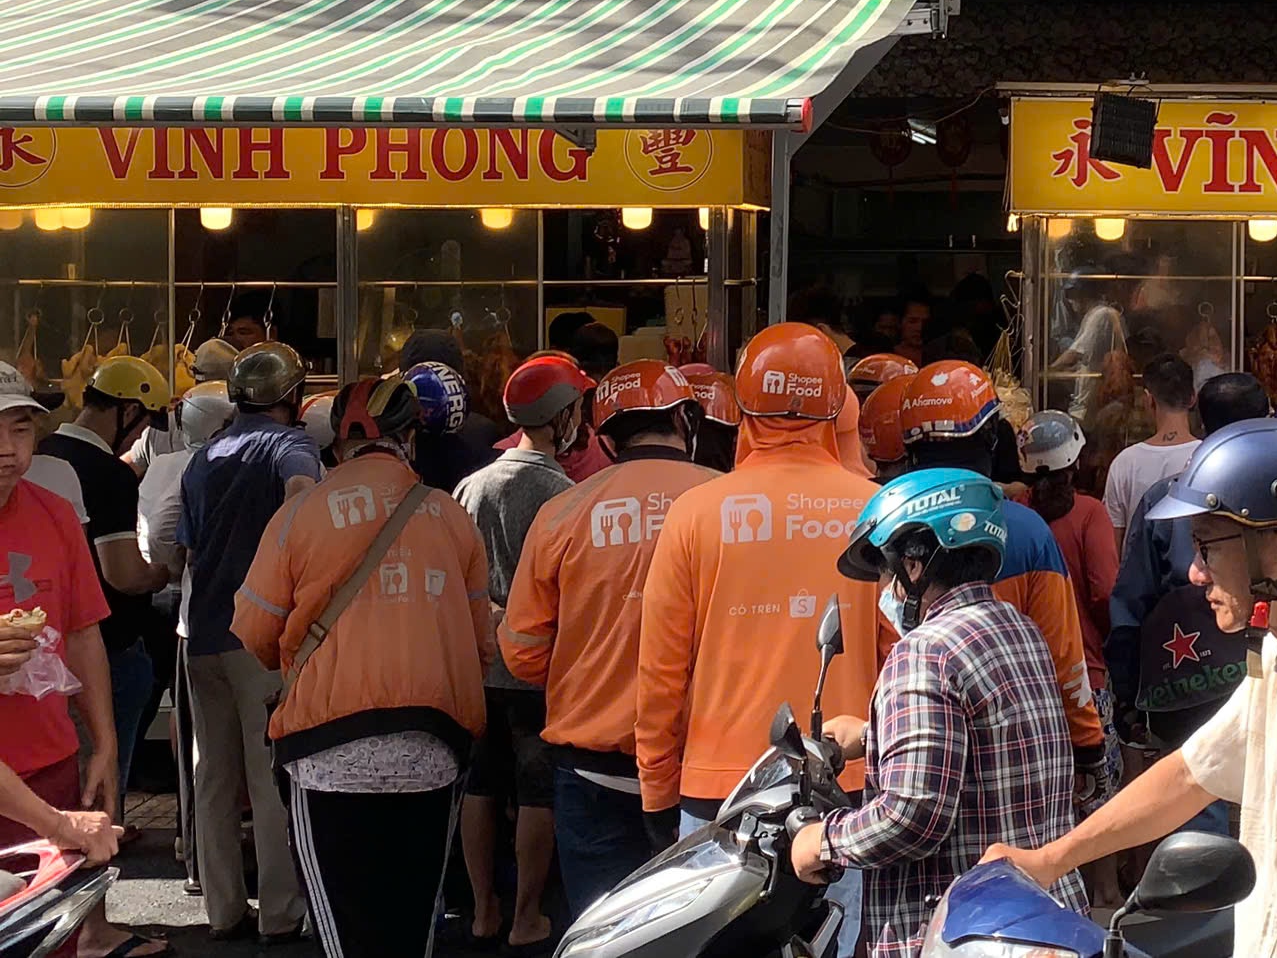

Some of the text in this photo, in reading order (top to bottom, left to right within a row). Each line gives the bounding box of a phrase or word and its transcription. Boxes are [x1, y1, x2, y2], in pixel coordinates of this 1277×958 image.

[320, 127, 591, 182] PHONG
[610, 378, 641, 393] Food
[612, 373, 641, 383] Shopee
[788, 373, 822, 385] Shopee
[786, 384, 822, 397] Food
[787, 493, 864, 513] Shopee
[907, 487, 961, 515] TOTAL
